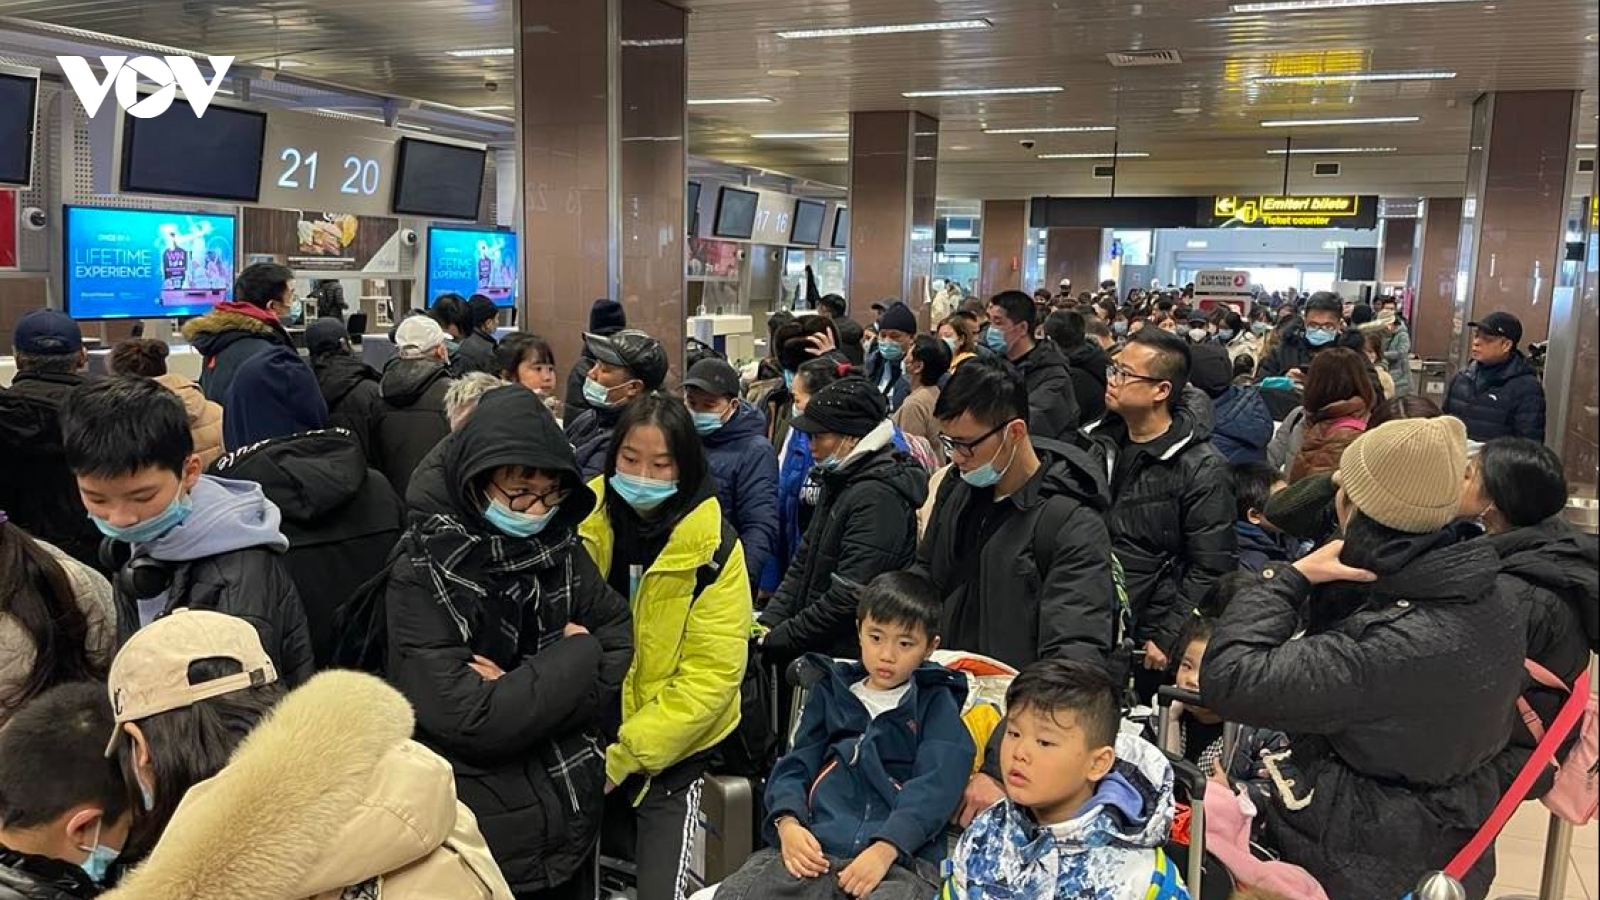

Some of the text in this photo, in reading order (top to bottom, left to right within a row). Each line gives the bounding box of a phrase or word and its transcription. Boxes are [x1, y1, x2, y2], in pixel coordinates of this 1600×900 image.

[278, 147, 318, 189] 21
[341, 156, 380, 195] 20
[754, 209, 770, 231] 17
[775, 213, 789, 233] 16
[1262, 216, 1331, 225] Ticket counter
[75, 248, 152, 266] LIFETIME
[75, 265, 152, 279] EXPERIENCE
